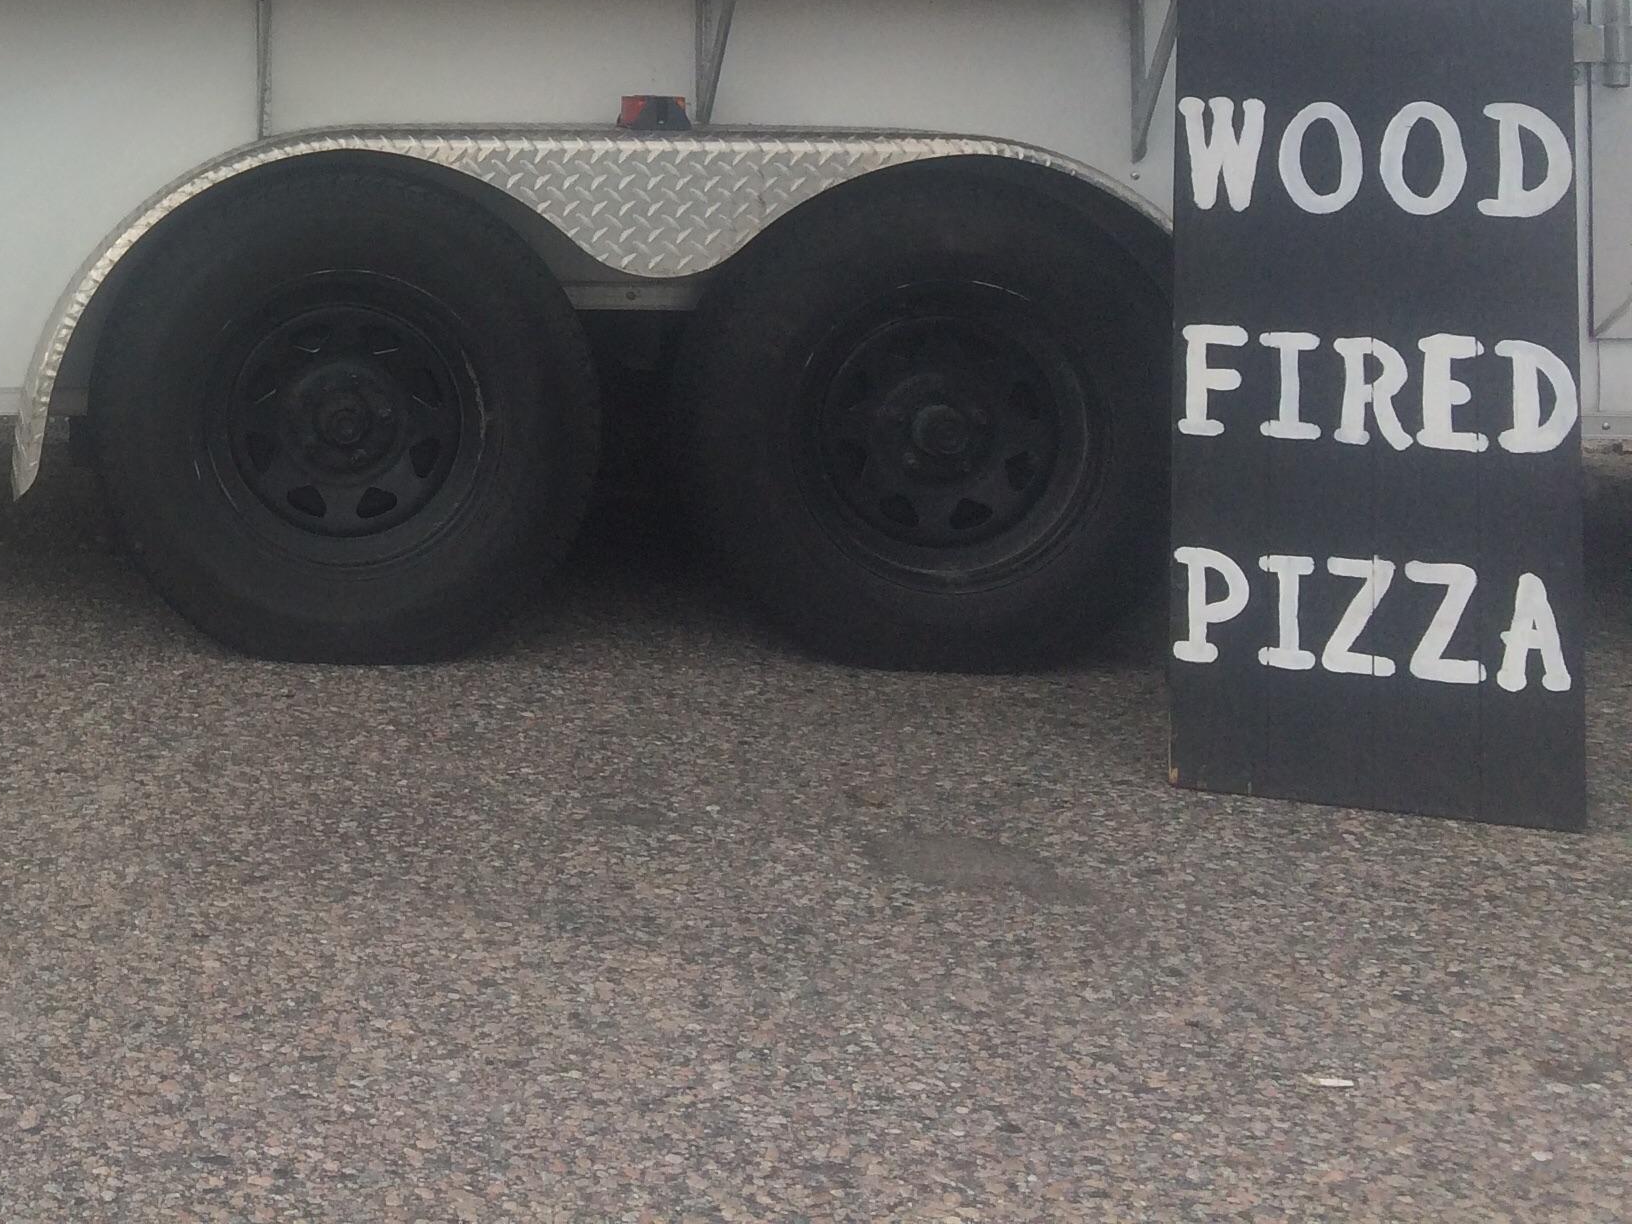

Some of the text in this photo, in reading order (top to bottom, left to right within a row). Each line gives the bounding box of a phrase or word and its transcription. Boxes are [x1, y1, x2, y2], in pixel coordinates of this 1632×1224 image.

[1177, 95, 1573, 219] WOOD
[1177, 323, 1579, 454] FIRED
[1173, 545, 1571, 693] PIZZA
